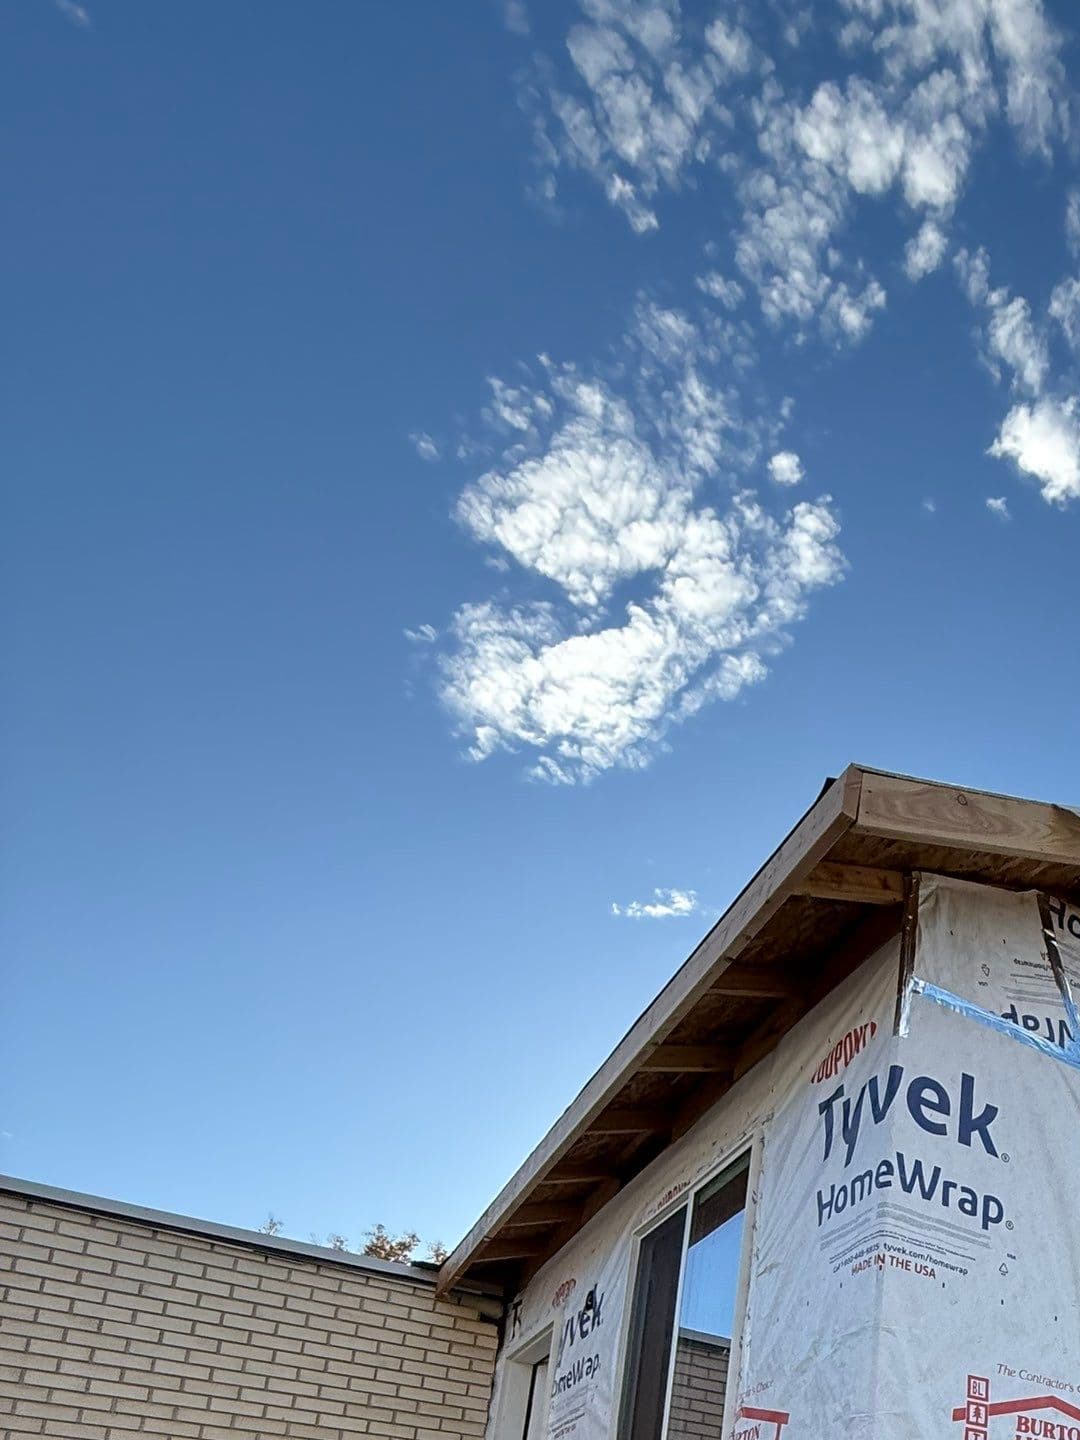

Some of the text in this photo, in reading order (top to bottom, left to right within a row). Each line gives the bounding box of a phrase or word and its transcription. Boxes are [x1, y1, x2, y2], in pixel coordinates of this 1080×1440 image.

[819, 1064, 1000, 1168] Tyvek
[816, 1151, 1004, 1230] HomeWrap
[874, 1253, 886, 1266] IN
[889, 1255, 911, 1271] THE
[914, 1262, 936, 1279] USA
[972, 1380, 984, 1396] BL
[997, 1364, 1017, 1377] The
[1019, 1369, 1074, 1394] Contractor's
